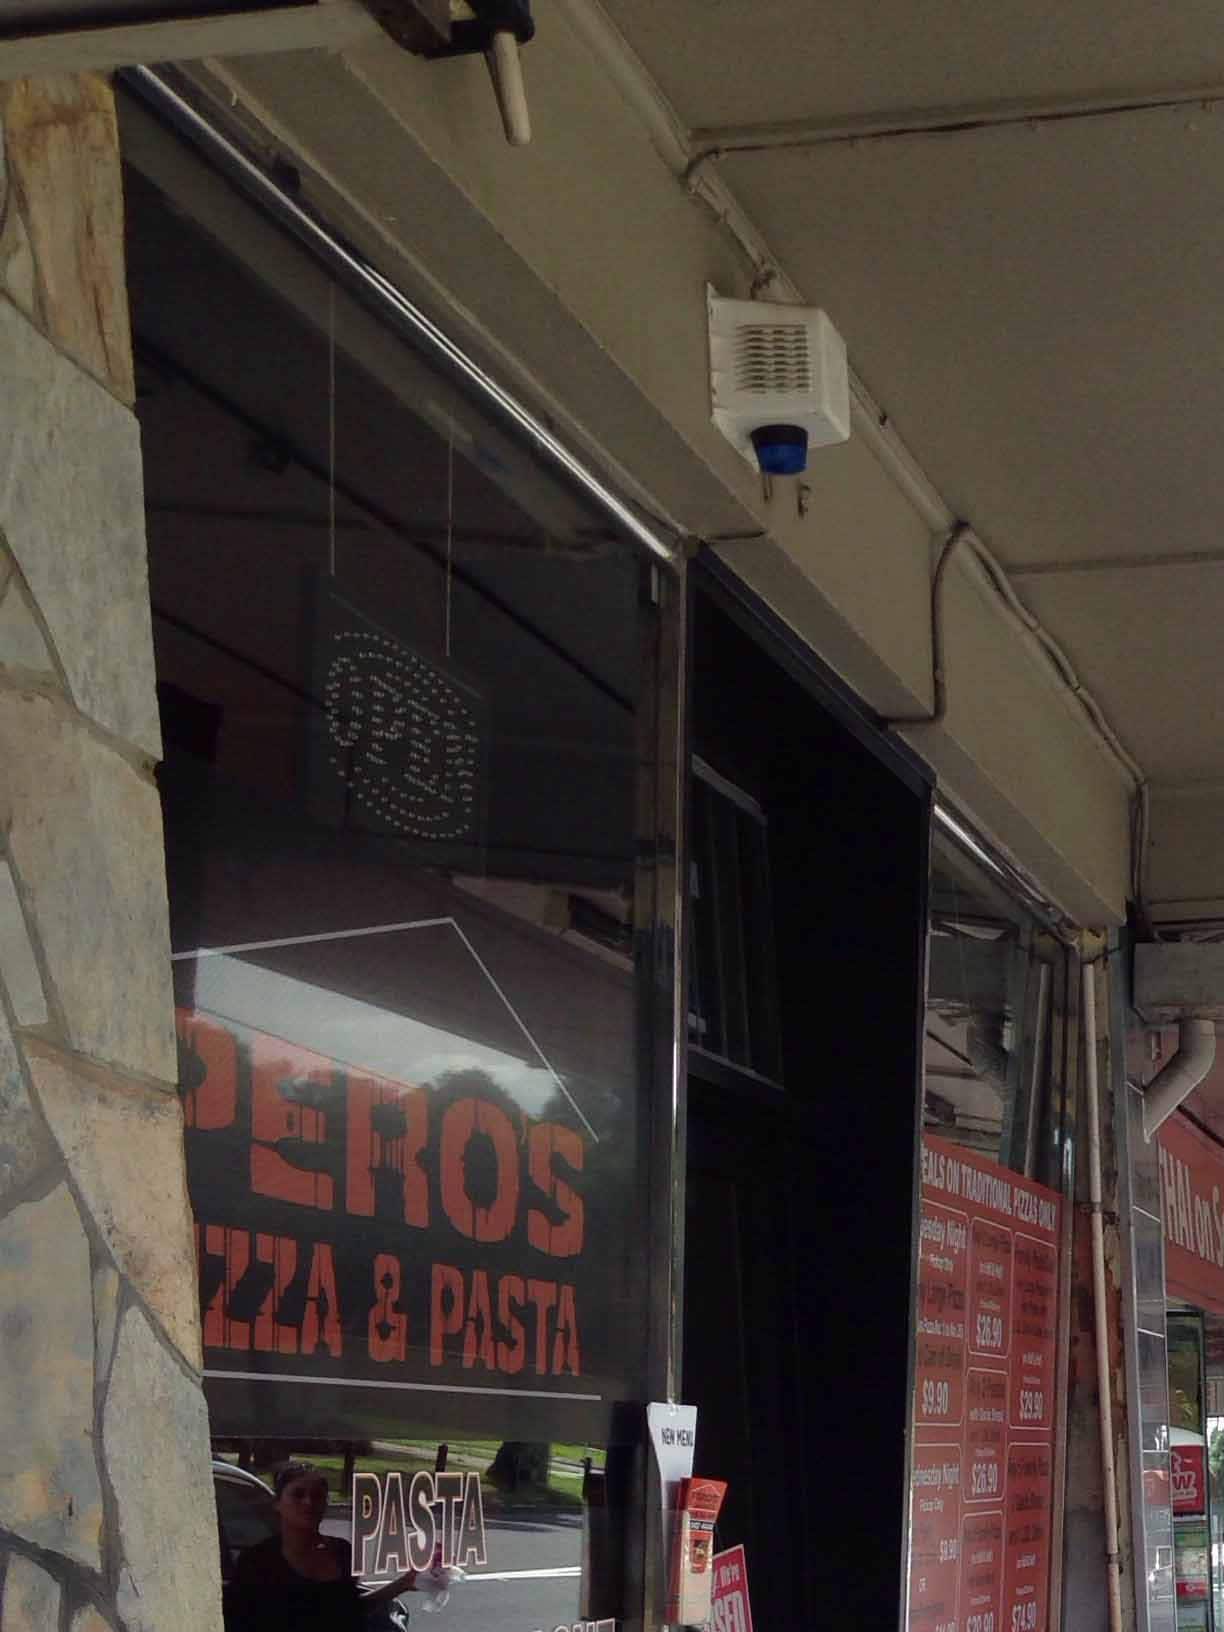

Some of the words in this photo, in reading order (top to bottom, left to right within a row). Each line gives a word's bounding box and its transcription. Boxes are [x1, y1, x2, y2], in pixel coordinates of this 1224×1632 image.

[946, 1159, 960, 1196] ON
[961, 1165, 1013, 1215] TRADITIONAL
[196, 1222, 343, 1358] ZZA
[368, 1254, 407, 1361] &
[430, 1264, 581, 1377] PASTA
[922, 1379, 949, 1416] $9.90
[661, 1427, 676, 1446] NEW
[351, 1472, 488, 1577] PASTA
